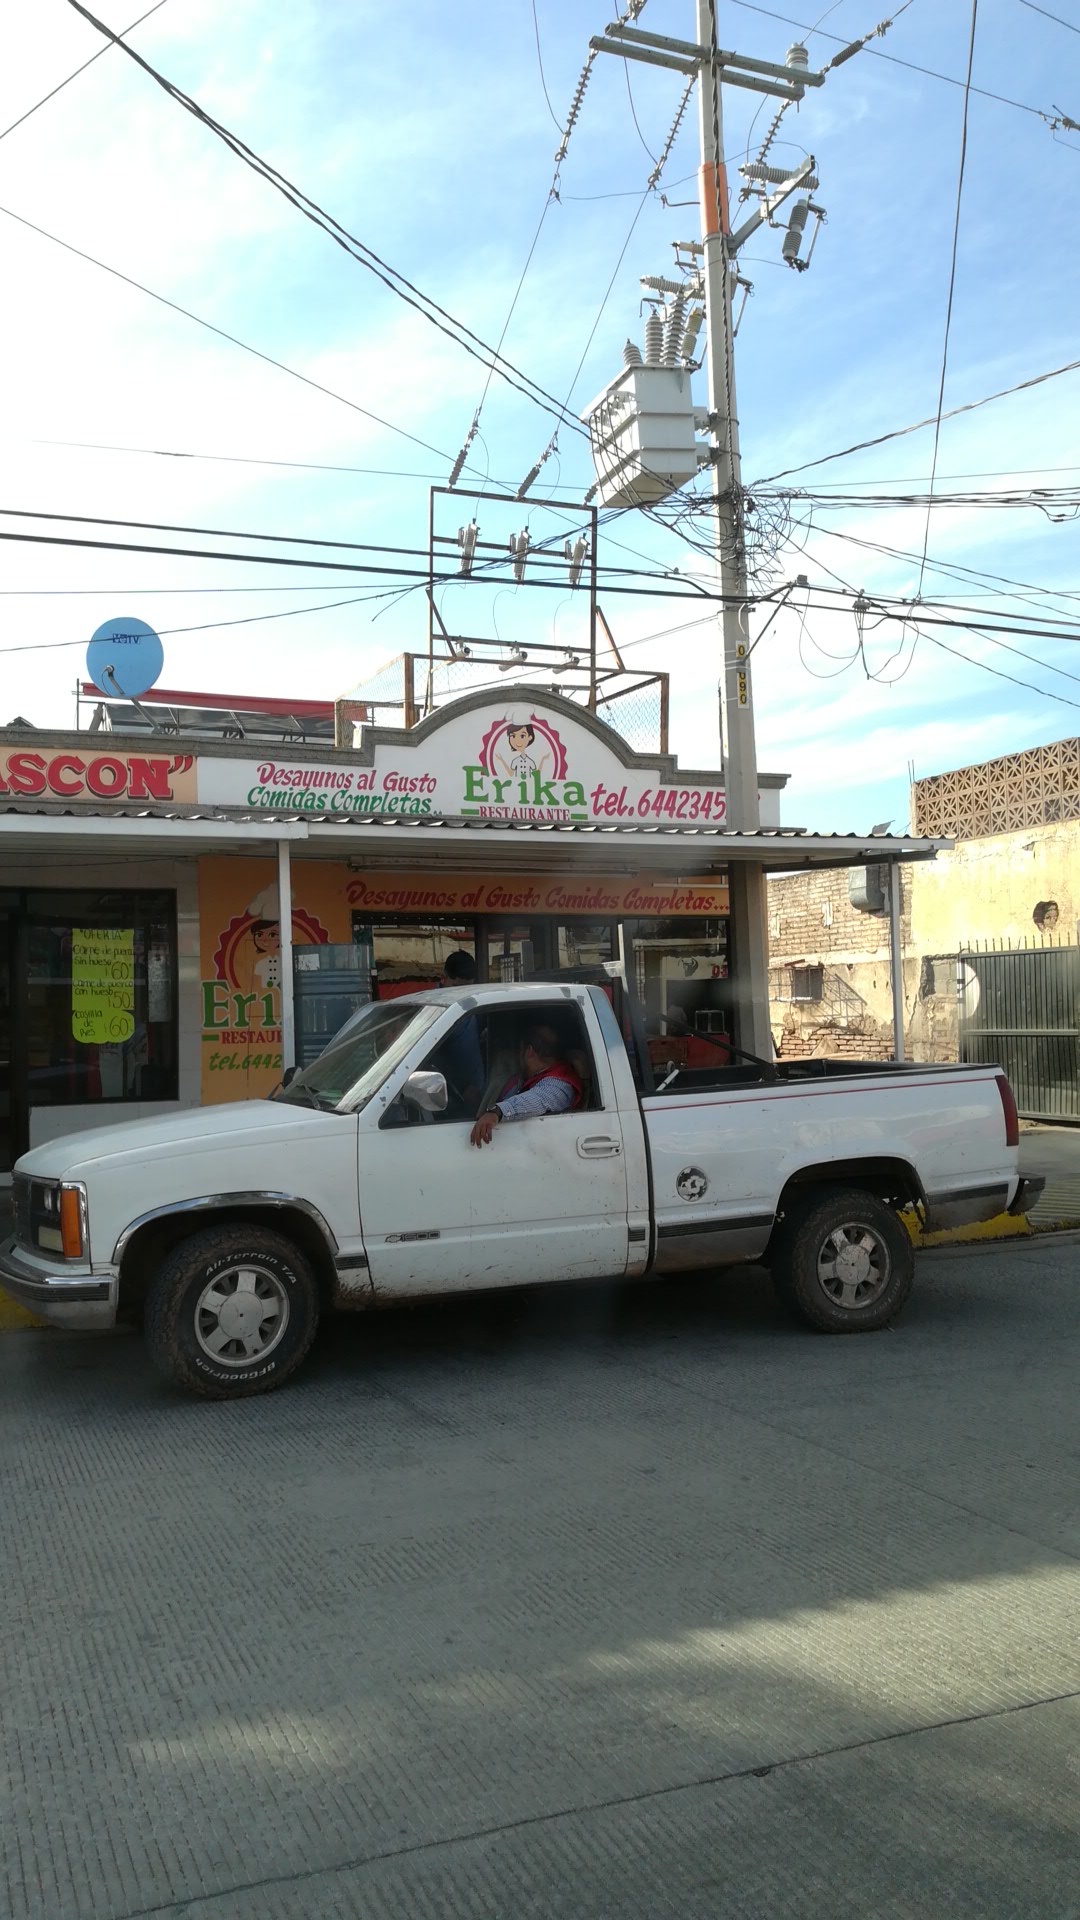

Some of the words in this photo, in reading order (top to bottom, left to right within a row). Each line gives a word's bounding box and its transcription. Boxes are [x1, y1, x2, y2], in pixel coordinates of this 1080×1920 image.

[256, 762, 354, 790] Desayunos
[357, 770, 377, 790] al
[382, 771, 437, 793] Gusto
[462, 765, 588, 807] Erika
[248, 786, 328, 810] Comidas
[331, 790, 432, 814] Completas
[479, 806, 570, 821] RESTAURANTE
[346, 880, 458, 911] Desayunos
[460, 885, 485, 908] al
[485, 885, 541, 908] Gusto
[545, 886, 620, 910] Comidas
[201, 979, 283, 1030] Eri
[402, 1231, 440, 1242] 1500
[205, 1251, 278, 1277] All-Terrain
[281, 1264, 297, 1284] T/A
[195, 1357, 276, 1380] BFGoodrich
